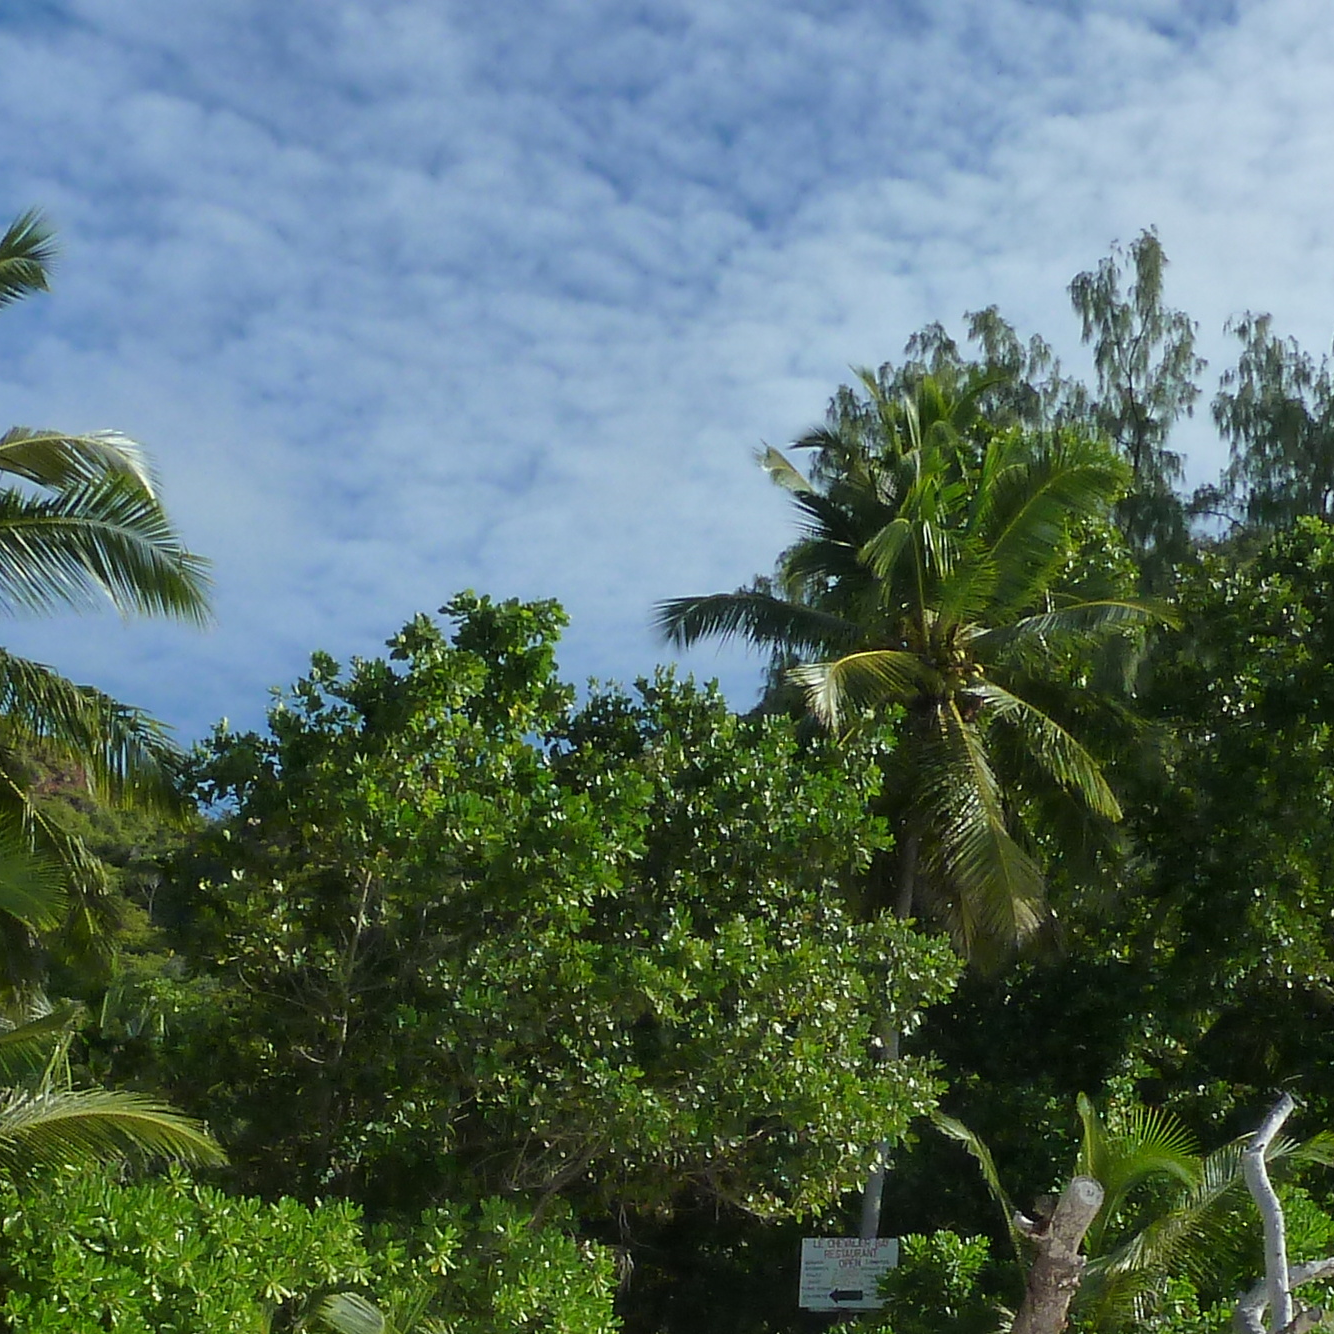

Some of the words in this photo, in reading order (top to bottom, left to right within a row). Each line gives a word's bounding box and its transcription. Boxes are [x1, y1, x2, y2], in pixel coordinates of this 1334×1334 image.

[813, 1239, 824, 1248] LE
[824, 1248, 877, 1259] RESTAURANT
[839, 1259, 862, 1268] OPEN
